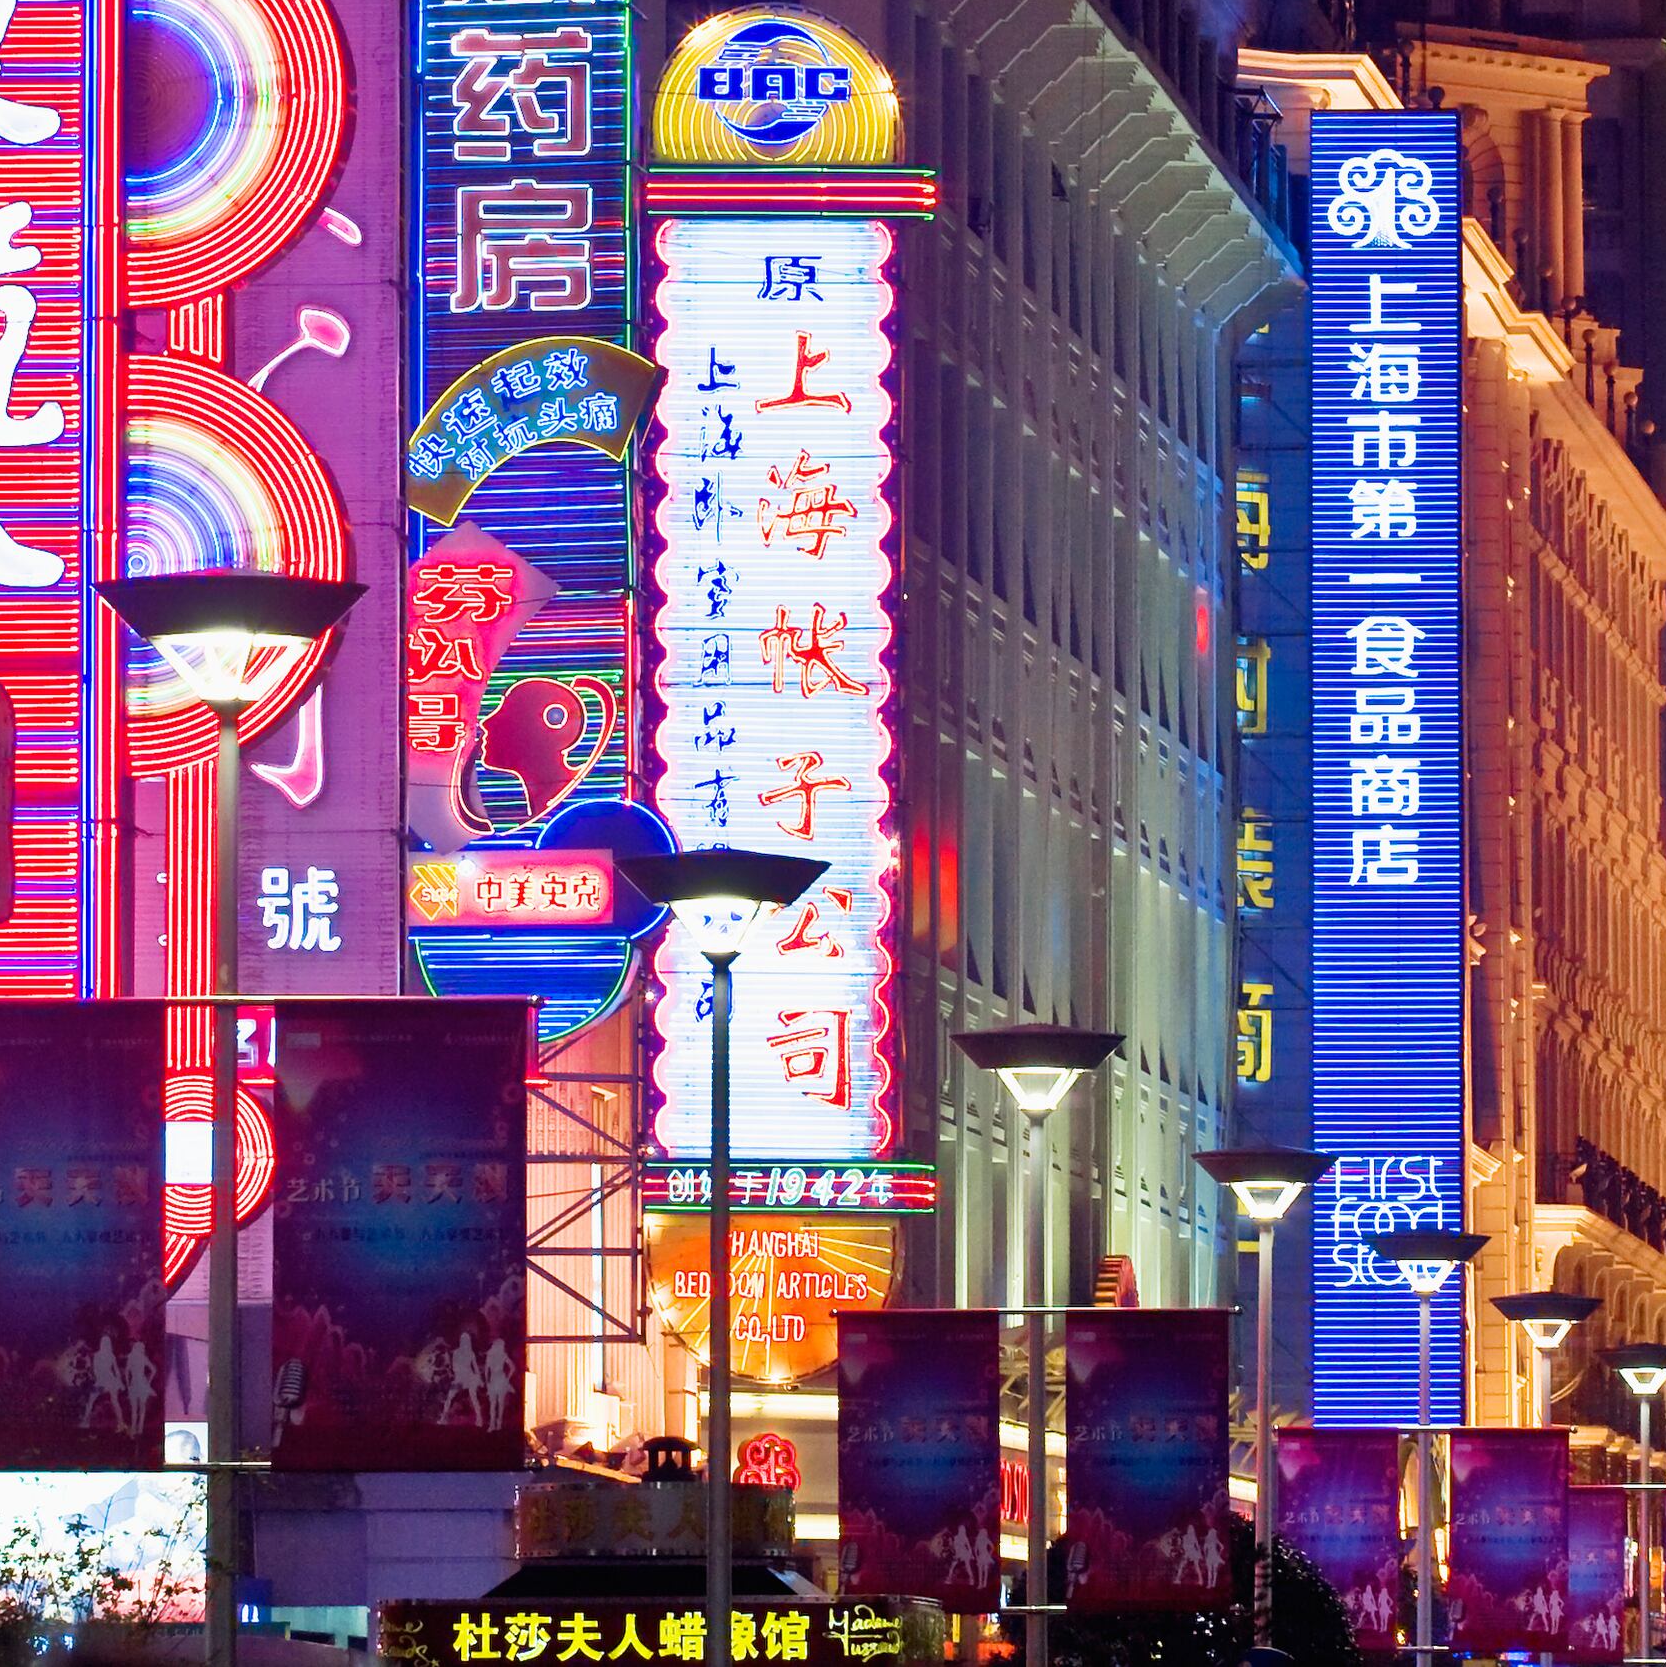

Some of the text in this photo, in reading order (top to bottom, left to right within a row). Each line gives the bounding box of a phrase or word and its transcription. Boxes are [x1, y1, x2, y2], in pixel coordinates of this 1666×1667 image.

[696, 64, 852, 102] BAC
[409, 348, 588, 479] 快速起效
[456, 393, 618, 480] 对抗头痛
[1346, 273, 1426, 887] 上海市第一食品商店
[474, 872, 602, 912] 中美史克
[730, 1229, 820, 1258] HANGHAI
[674, 1270, 765, 1299] BEDOM
